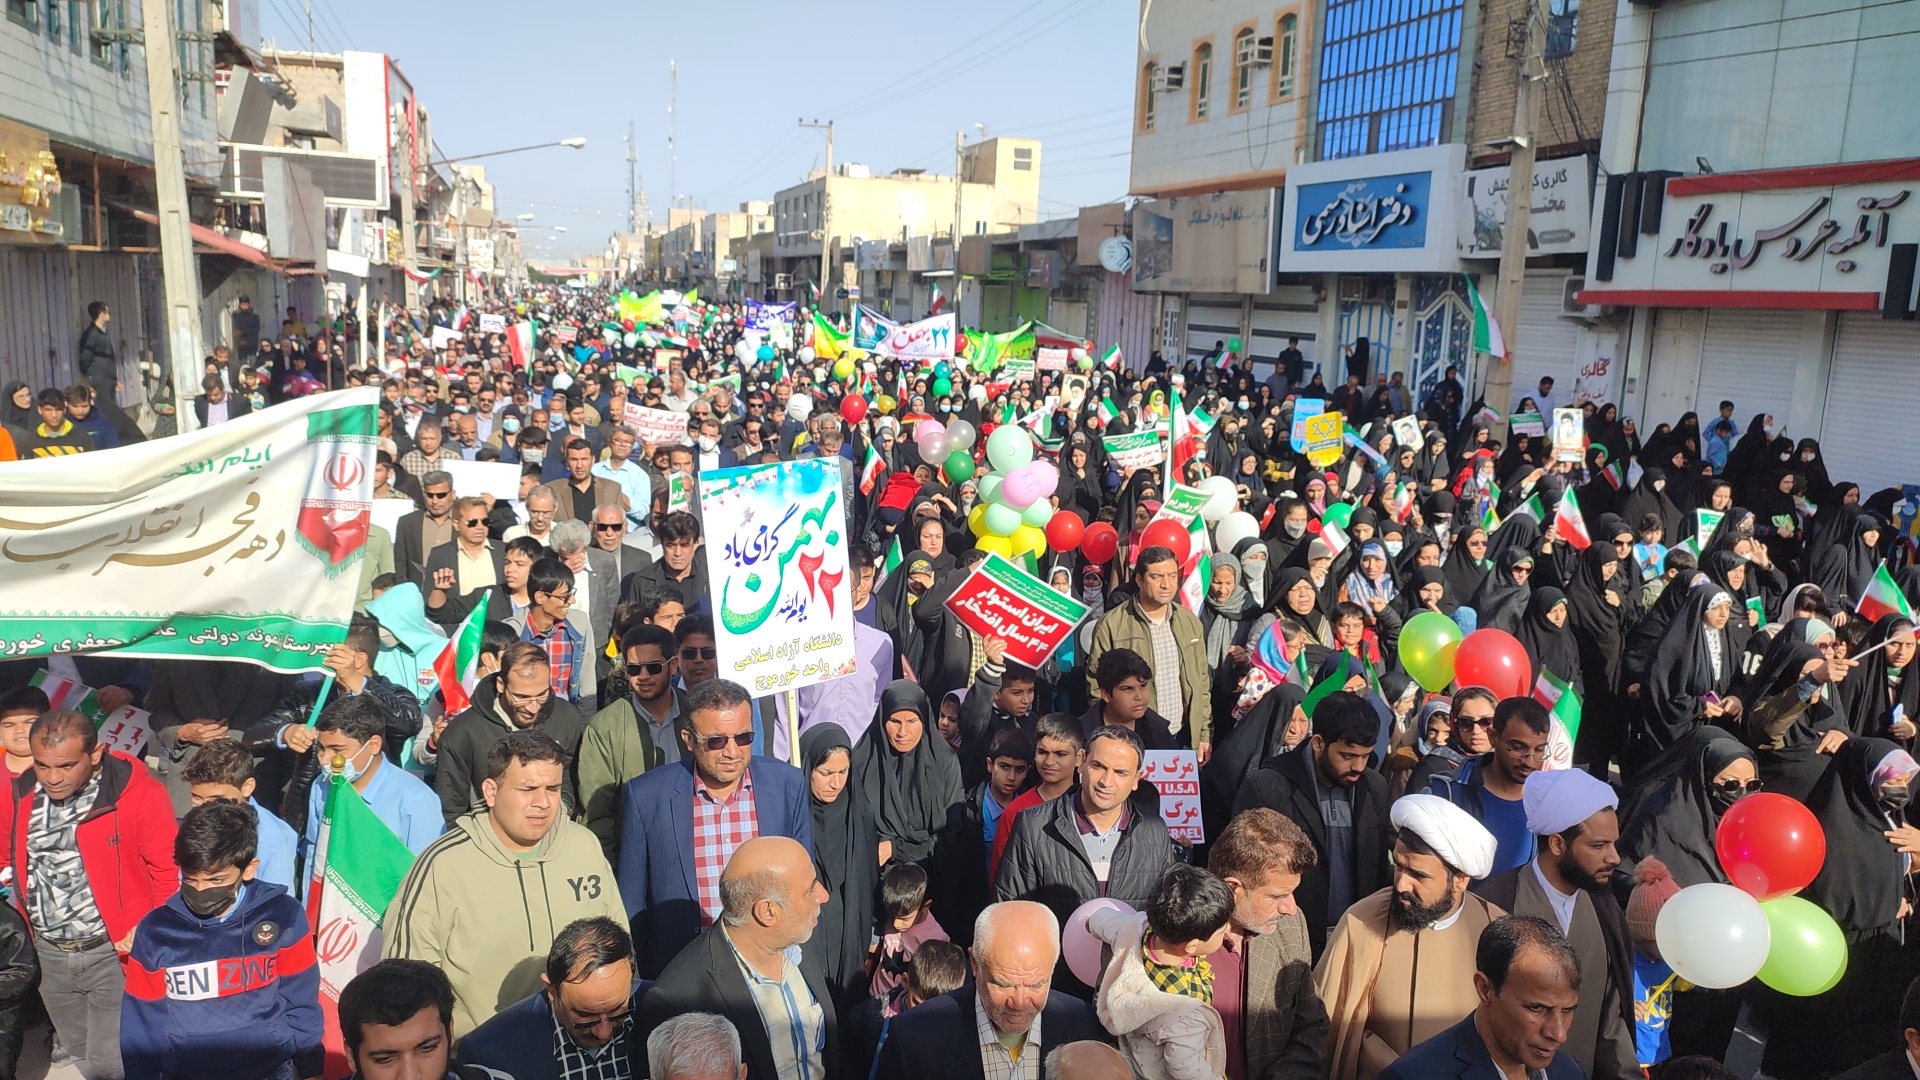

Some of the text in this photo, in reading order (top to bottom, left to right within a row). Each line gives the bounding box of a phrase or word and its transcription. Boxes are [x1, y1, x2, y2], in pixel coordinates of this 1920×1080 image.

[1541, 168, 1568, 189] گالری
[1302, 182, 1411, 245] دفتر اسناد رسمی
[1664, 190, 1911, 274] آتلیه عروس یادگار
[892, 327, 931, 350] بهمن
[932, 325, 951, 349] ۲۲
[1581, 358, 1611, 380] گالری
[161, 443, 272, 480] ایام الله
[92, 476, 261, 577] فجر
[1159, 511, 1172, 519] WE
[2, 503, 206, 571] انقلاب
[225, 528, 286, 565] دهه
[724, 502, 800, 568] گرامی باد
[721, 490, 844, 635] ۲۲ بهمن
[976, 587, 1029, 619] استوار
[188, 626, 240, 646] دولتی
[955, 597, 1049, 652] ۴۴ سال افتخار
[1021, 612, 1060, 635] ایران
[734, 631, 843, 671] دانشگاه آزاد اسلامی
[755, 658, 829, 691] واحد خورموج
[1142, 754, 1194, 780] مرگ بر
[1165, 783, 1195, 794] U.S.A
[1165, 800, 1199, 824] مرگ
